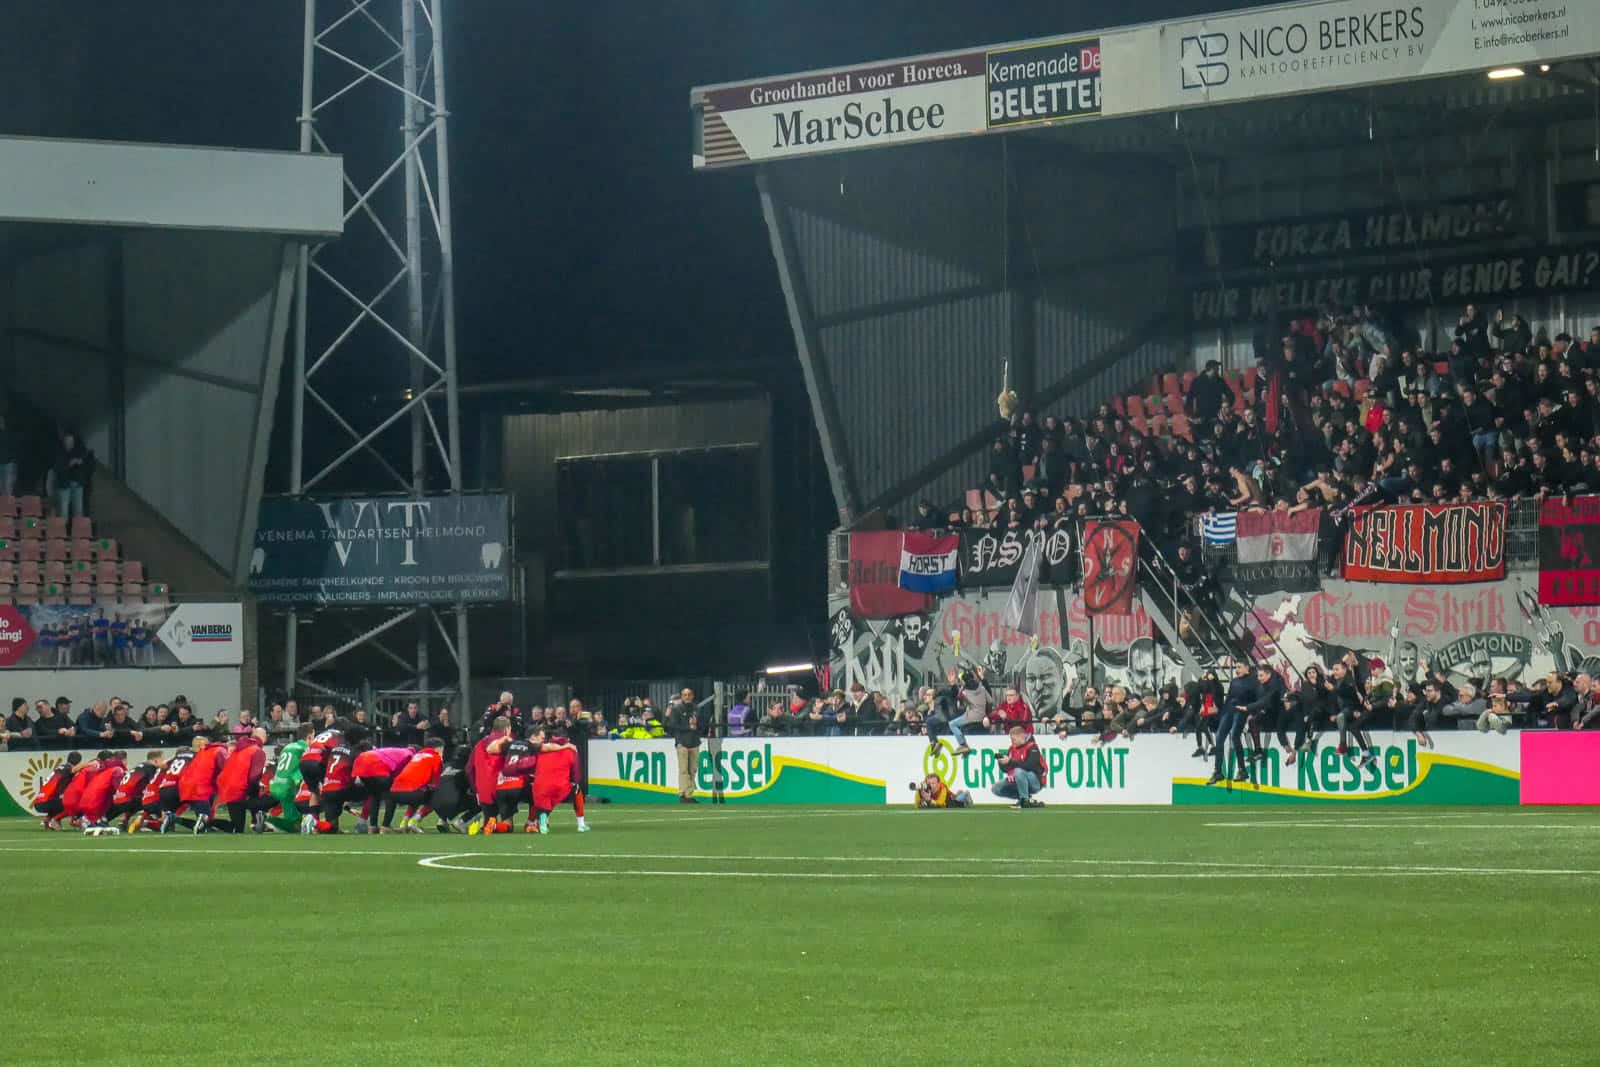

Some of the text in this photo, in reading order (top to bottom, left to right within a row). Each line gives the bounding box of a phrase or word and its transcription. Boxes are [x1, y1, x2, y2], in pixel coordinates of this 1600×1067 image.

[1240, 7, 1425, 61] NICO BERKERS
[1480, 6, 1566, 29] www.nicoberkers.nl
[989, 54, 1078, 83] Kemenade
[1240, 47, 1400, 79] KANTOOREFFICIENCY
[750, 61, 968, 105] Groothandel voor Horeca.
[773, 98, 945, 148] MarSchee
[1254, 218, 1351, 258] FORZA
[1442, 257, 1525, 297] BENDE
[1535, 251, 1599, 289] GAI?
[257, 526, 486, 541] VENEMA TANDARTSEN HELMOND
[207, 624, 232, 634] BERLO
[277, 752, 293, 772] 21
[329, 754, 341, 774] 7
[617, 751, 666, 786] van
[1297, 739, 1417, 792] Kessel
